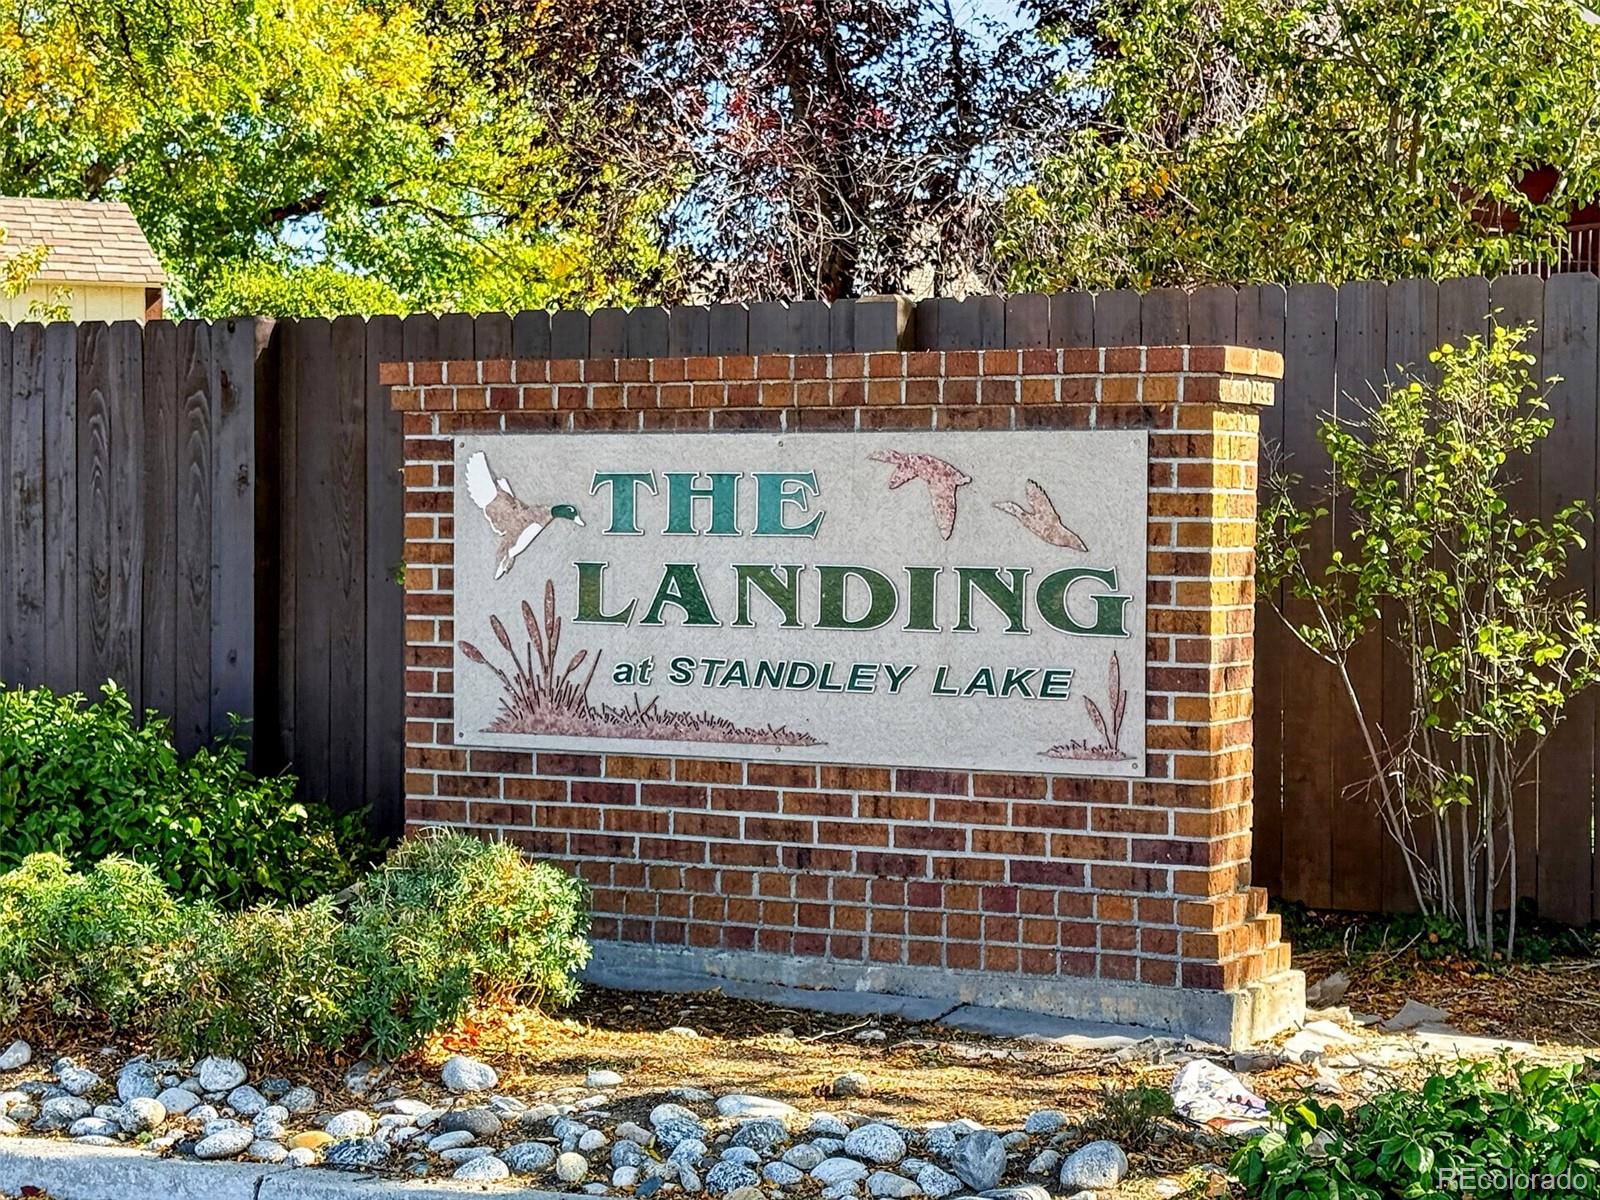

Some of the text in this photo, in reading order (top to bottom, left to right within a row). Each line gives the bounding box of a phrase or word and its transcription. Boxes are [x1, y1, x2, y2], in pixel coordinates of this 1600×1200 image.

[589, 469, 825, 539] THE
[571, 561, 1133, 638] LANDING
[612, 655, 1075, 700] at STANDLEY LAKE
